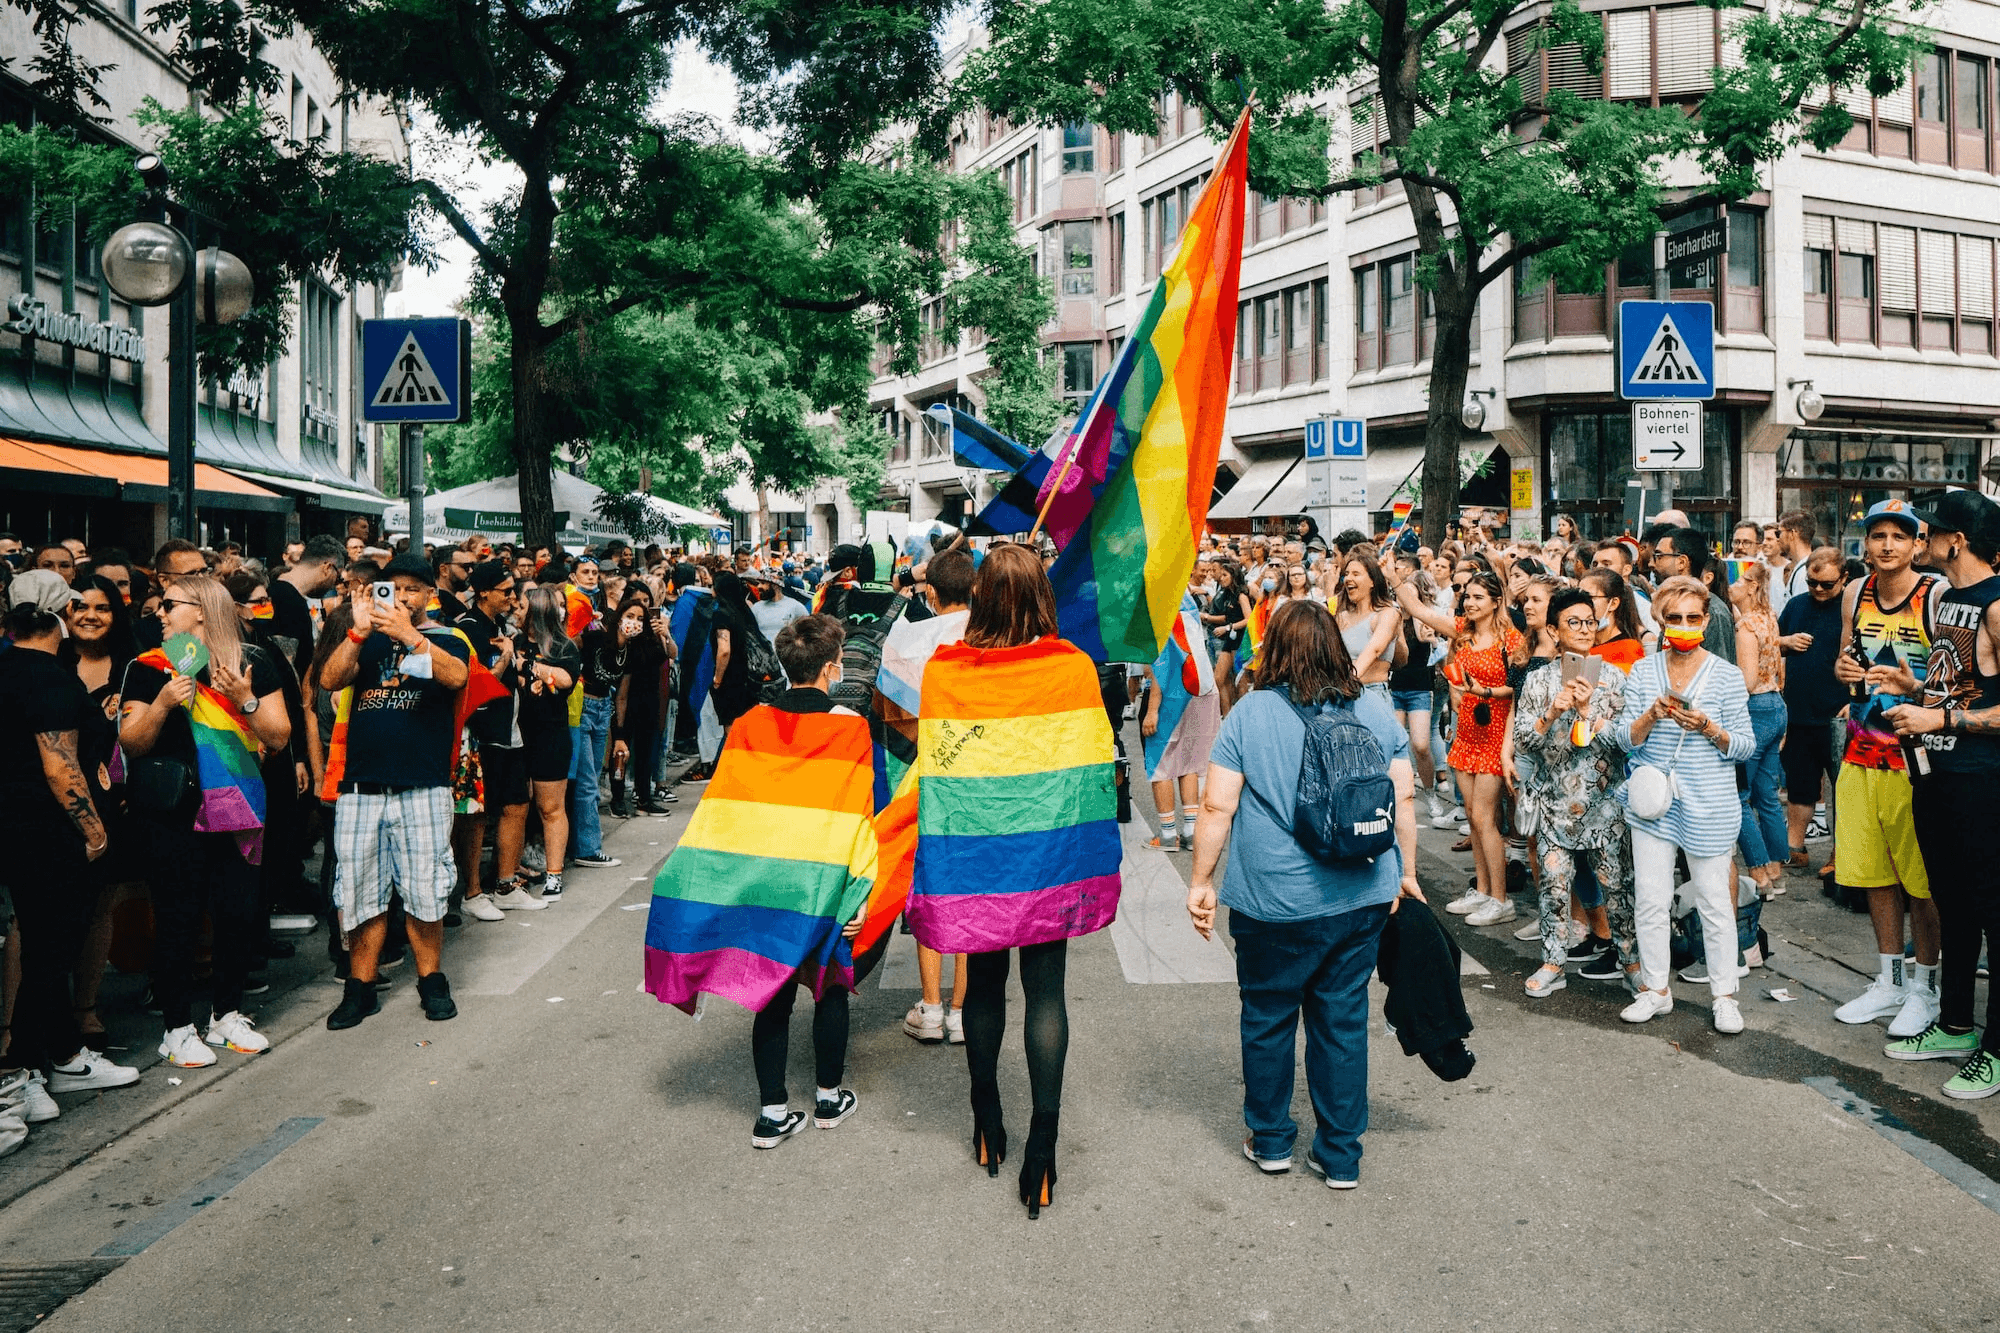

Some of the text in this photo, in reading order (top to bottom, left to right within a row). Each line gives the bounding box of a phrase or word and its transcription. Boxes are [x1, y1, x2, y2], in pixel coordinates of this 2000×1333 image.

[1667, 229, 1722, 261] Eberhardstr.
[16, 293, 108, 354] Schwaben
[1640, 407, 1696, 419] Bohnen-
[1310, 424, 1322, 449] U
[1338, 422, 1358, 448] U
[1647, 422, 1689, 434] viertel
[391, 690, 422, 699] LOVE
[358, 698, 384, 711] LESS
[1353, 818, 1388, 836] PUMA
